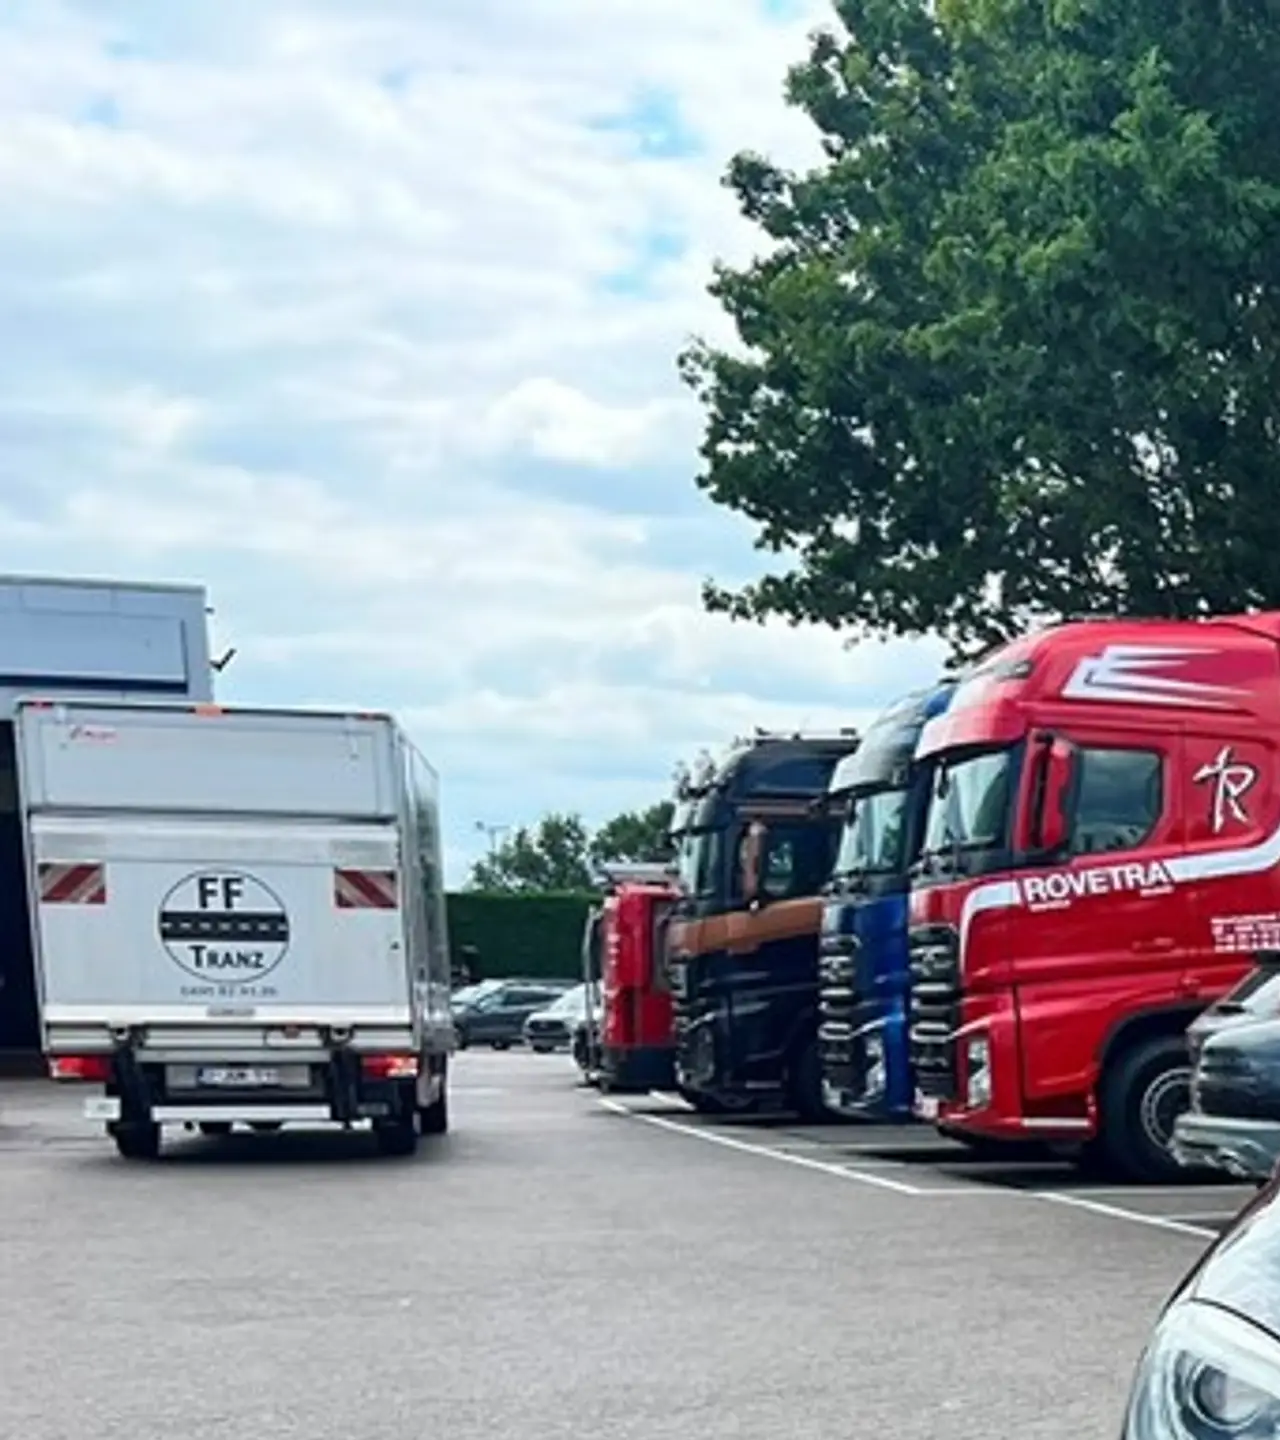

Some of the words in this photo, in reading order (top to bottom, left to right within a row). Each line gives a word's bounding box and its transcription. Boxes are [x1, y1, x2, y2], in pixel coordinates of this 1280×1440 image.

[198, 876, 243, 909] FF
[1023, 860, 1170, 901] ROVETRA
[187, 944, 265, 969] TRANZ
